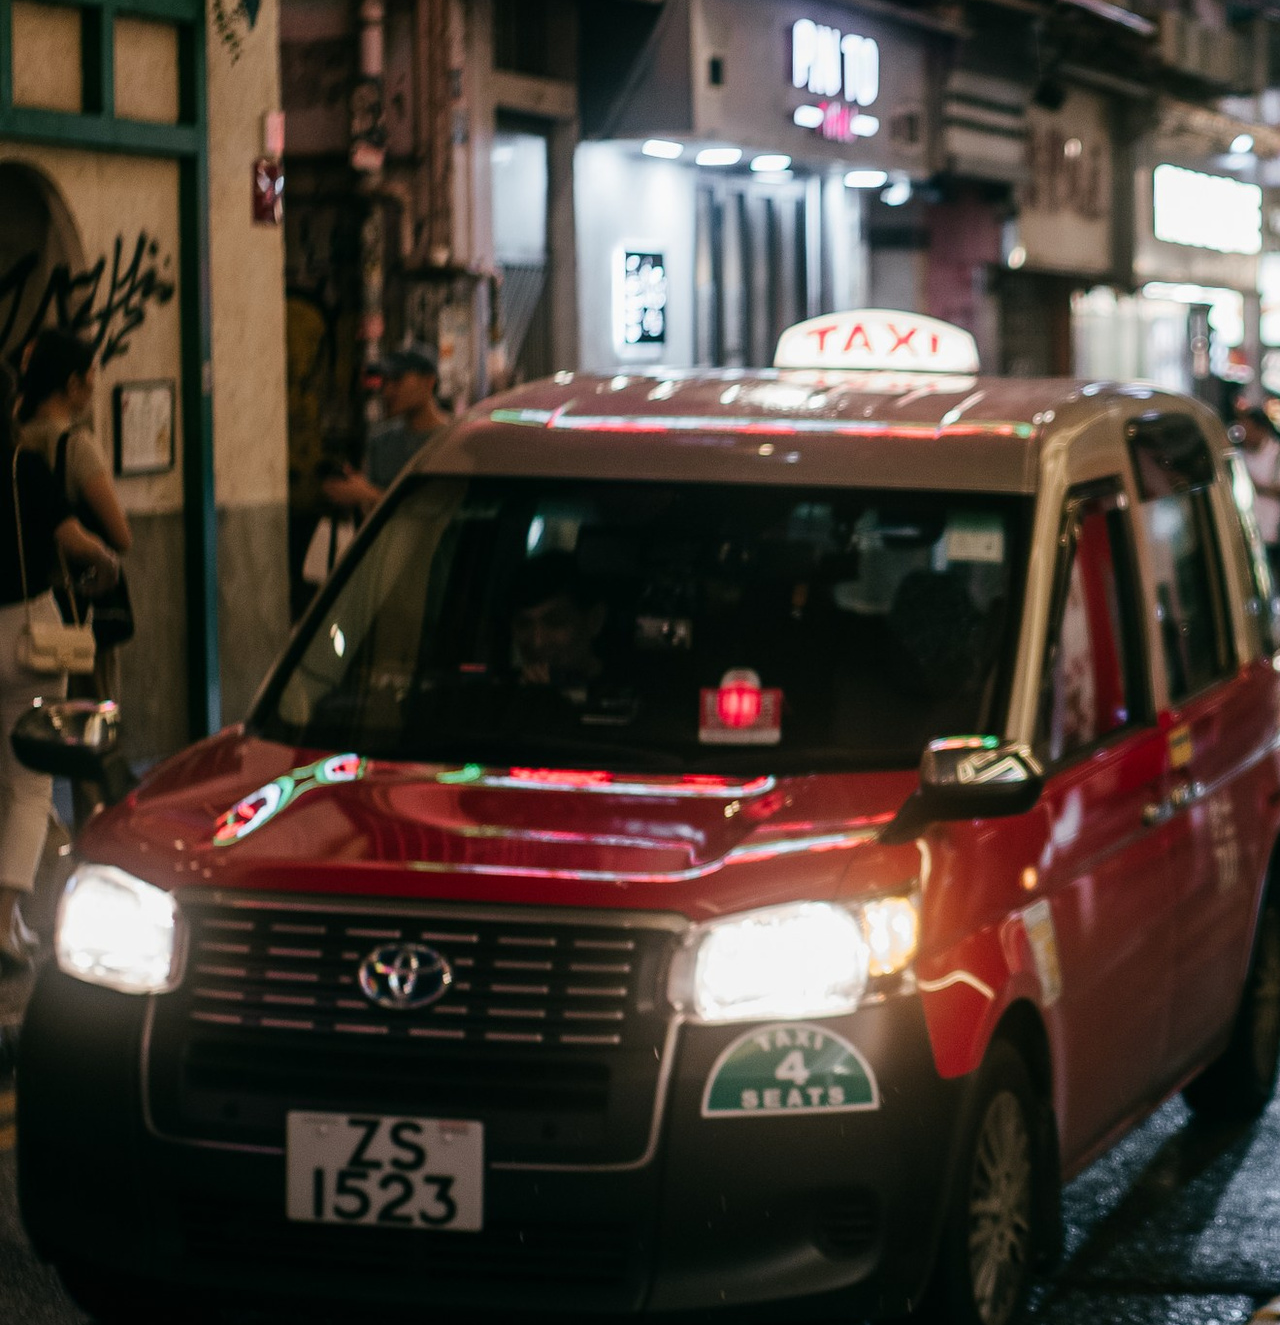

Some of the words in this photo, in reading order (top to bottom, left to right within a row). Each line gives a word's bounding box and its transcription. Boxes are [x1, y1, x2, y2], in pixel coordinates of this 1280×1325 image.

[806, 323, 940, 355] TAXI
[755, 1028, 824, 1052] TAXI
[775, 1049, 811, 1086] 4
[741, 1086, 845, 1109] SEATS
[347, 1119, 427, 1170] ZS
[314, 1168, 457, 1225] 1523
